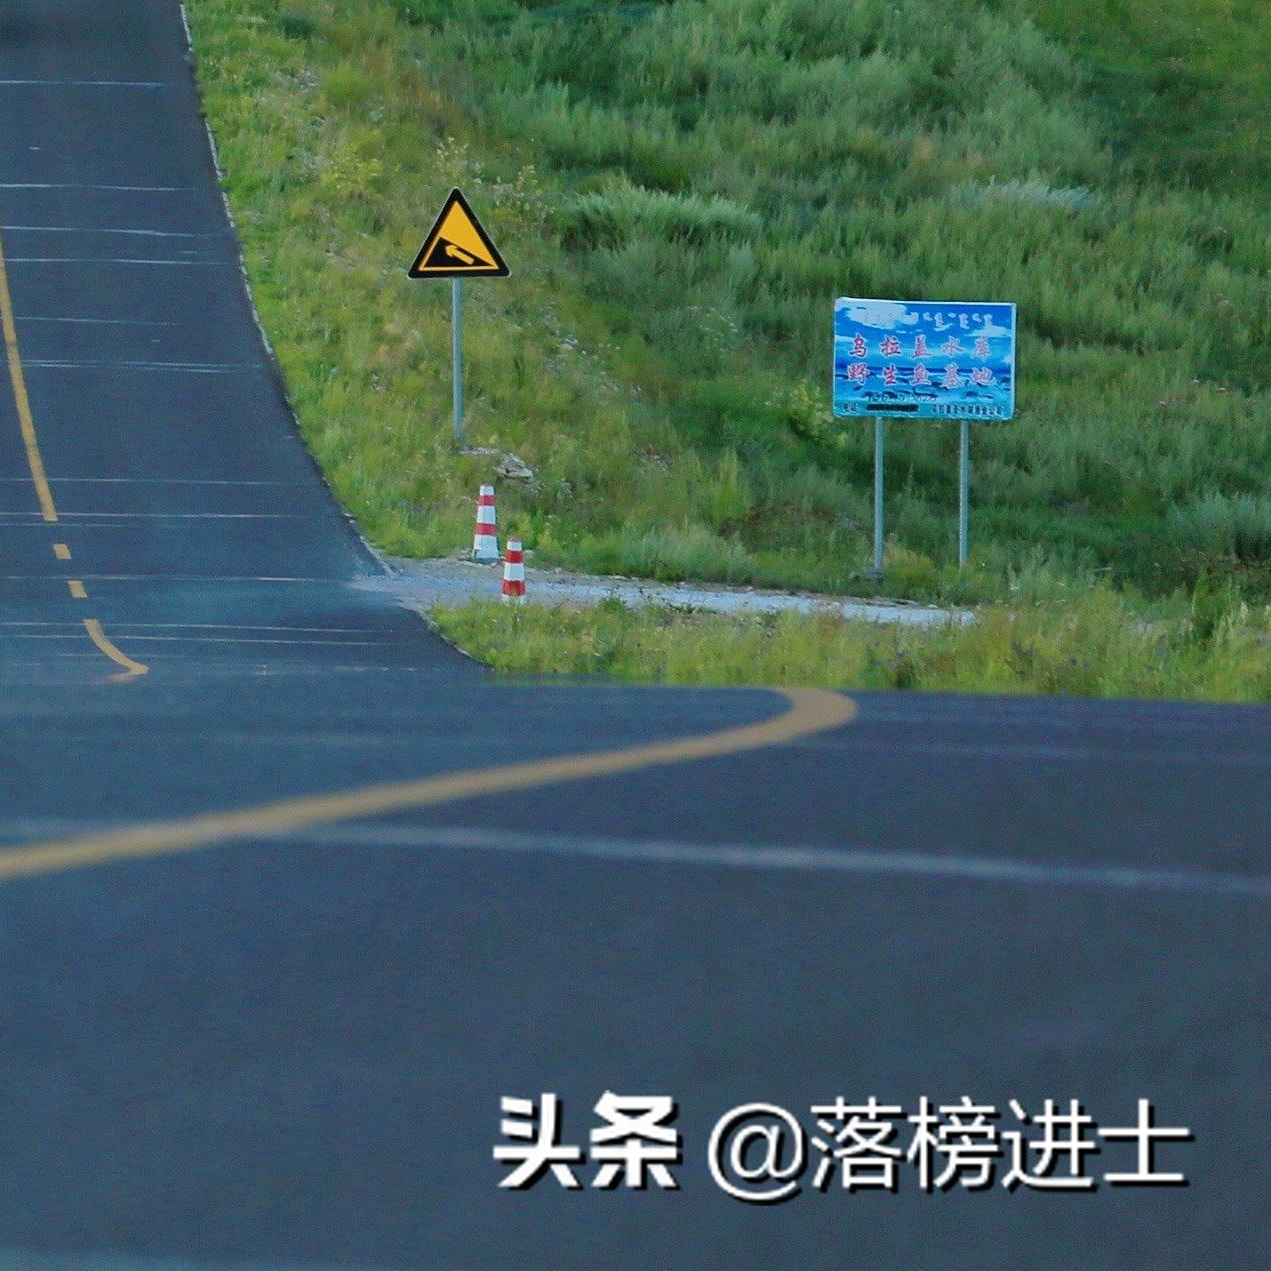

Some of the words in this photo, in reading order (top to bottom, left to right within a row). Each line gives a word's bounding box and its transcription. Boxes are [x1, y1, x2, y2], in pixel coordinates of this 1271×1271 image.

[849, 332, 991, 360] 乌拉盖水库
[847, 362, 995, 389] 野生鱼基地
